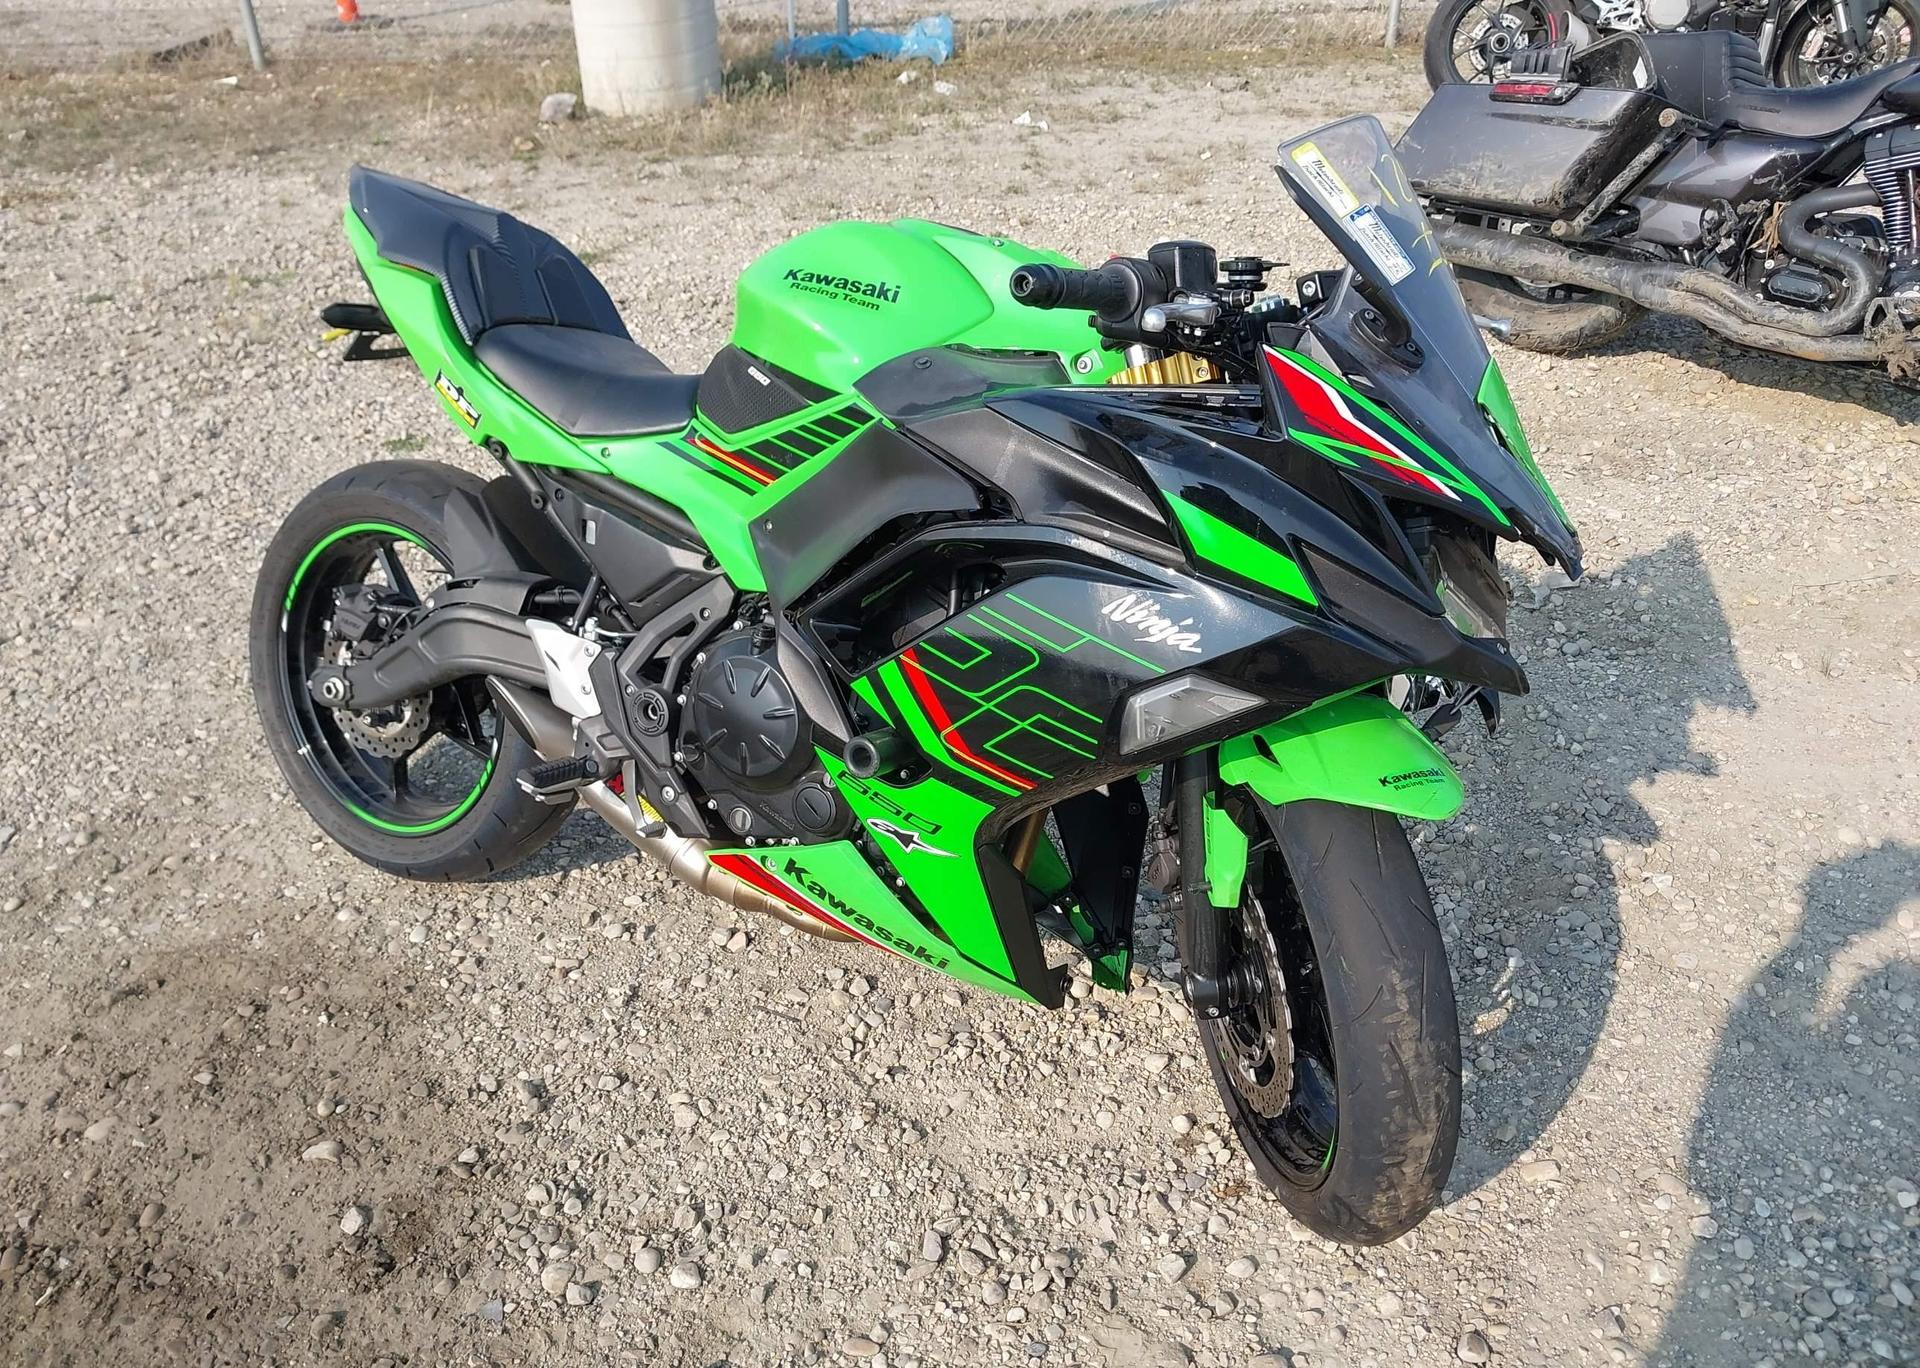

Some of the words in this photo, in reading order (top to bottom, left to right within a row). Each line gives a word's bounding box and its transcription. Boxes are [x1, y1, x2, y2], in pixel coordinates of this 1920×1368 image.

[783, 268, 901, 304] Kawasaki
[790, 281, 840, 300] Racing
[842, 292, 880, 311] Team
[1101, 593, 1202, 654] Ninja
[1378, 767, 1446, 786] Kawasaki
[1393, 779, 1425, 792] Racing
[1426, 777, 1446, 785] Team
[784, 857, 950, 970] Kawasaki
